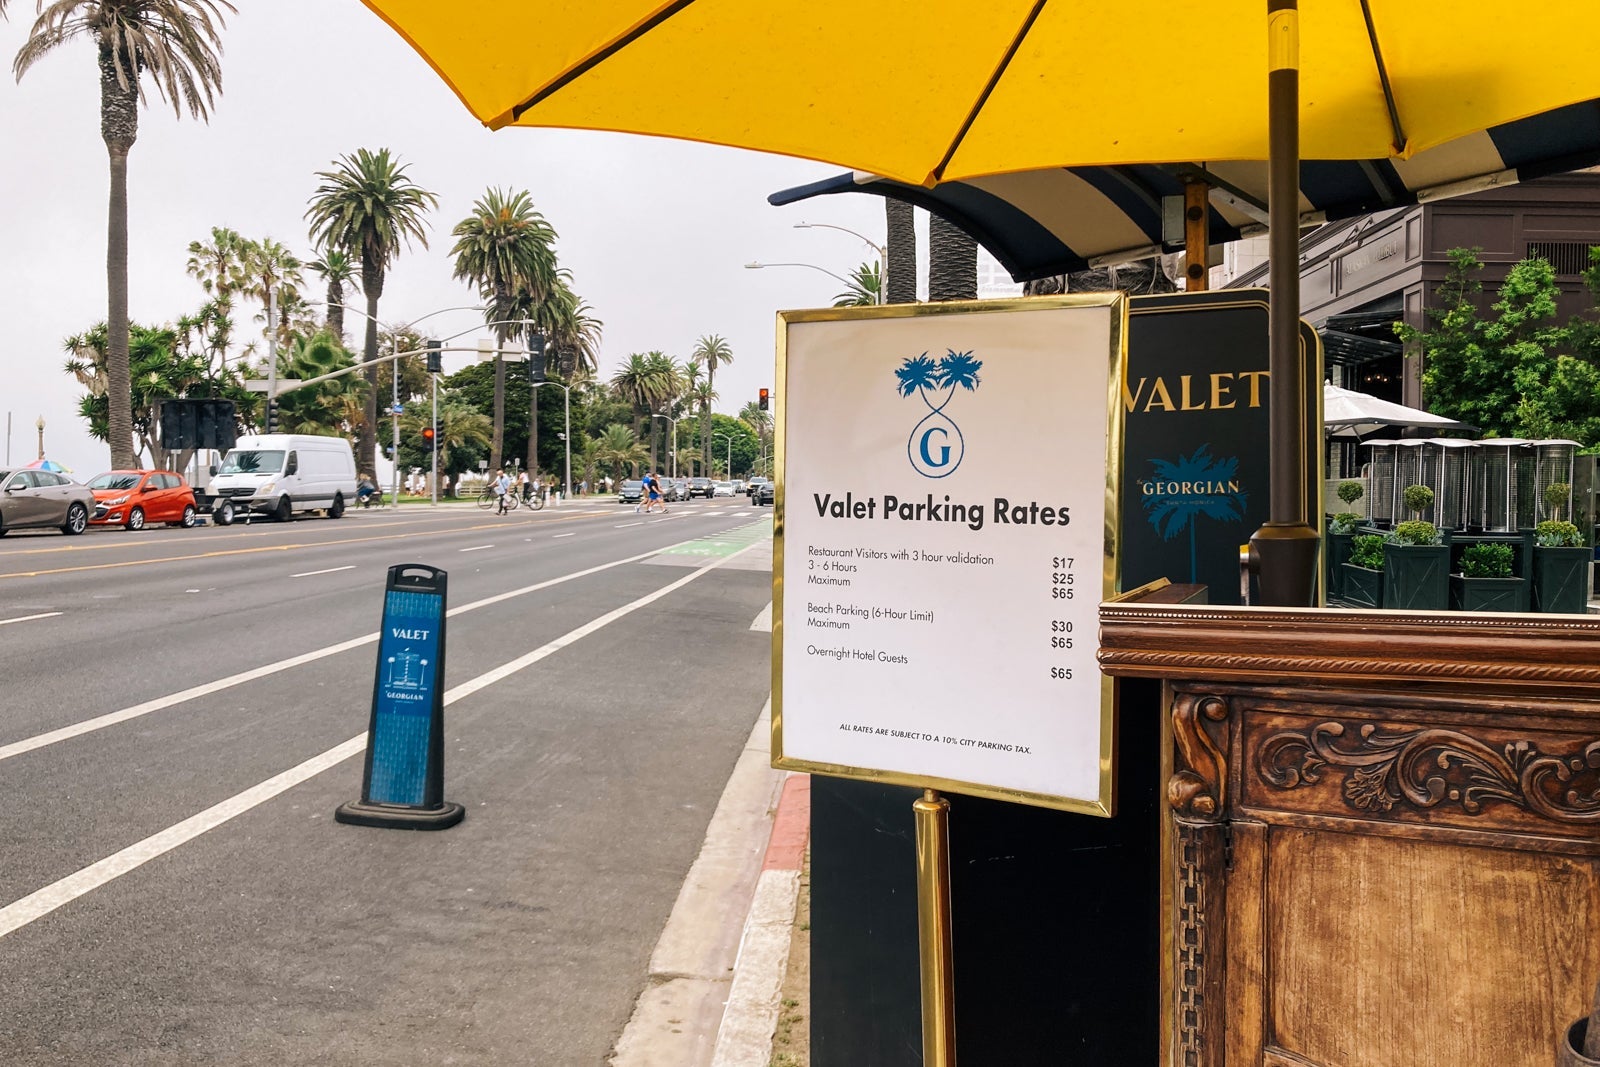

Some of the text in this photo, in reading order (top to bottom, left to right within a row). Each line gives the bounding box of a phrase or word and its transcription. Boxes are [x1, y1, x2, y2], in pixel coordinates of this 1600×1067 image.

[1124, 370, 1271, 413] VALET
[919, 427, 952, 468] G
[1142, 480, 1239, 496] GEORGIAN
[814, 492, 1070, 530] Valet Parking Rates
[808, 545, 994, 564] Restaurant Visitors with 3 hour validation
[809, 560, 814, 569] 3
[823, 561, 829, 570] 6
[832, 562, 857, 572] Hours
[1053, 557, 1074, 569] $17
[808, 575, 850, 586] Maximum
[1053, 573, 1073, 584] $25
[1052, 587, 1073, 599] $65
[807, 603, 933, 623] Beach Parking (6-Hour Limit)
[808, 617, 849, 629] Maximum
[1052, 620, 1072, 632] $30
[392, 627, 430, 641] VALET
[1052, 636, 1072, 648] $65
[807, 645, 908, 664] Overnight Hotel Guests
[1051, 667, 1072, 679] $65
[386, 691, 425, 701] GEORGIAN
[853, 725, 873, 733] RATES
[891, 730, 919, 739] SUBJECT
[978, 741, 1012, 751] PARKING
[1016, 746, 1031, 754] TAX.
